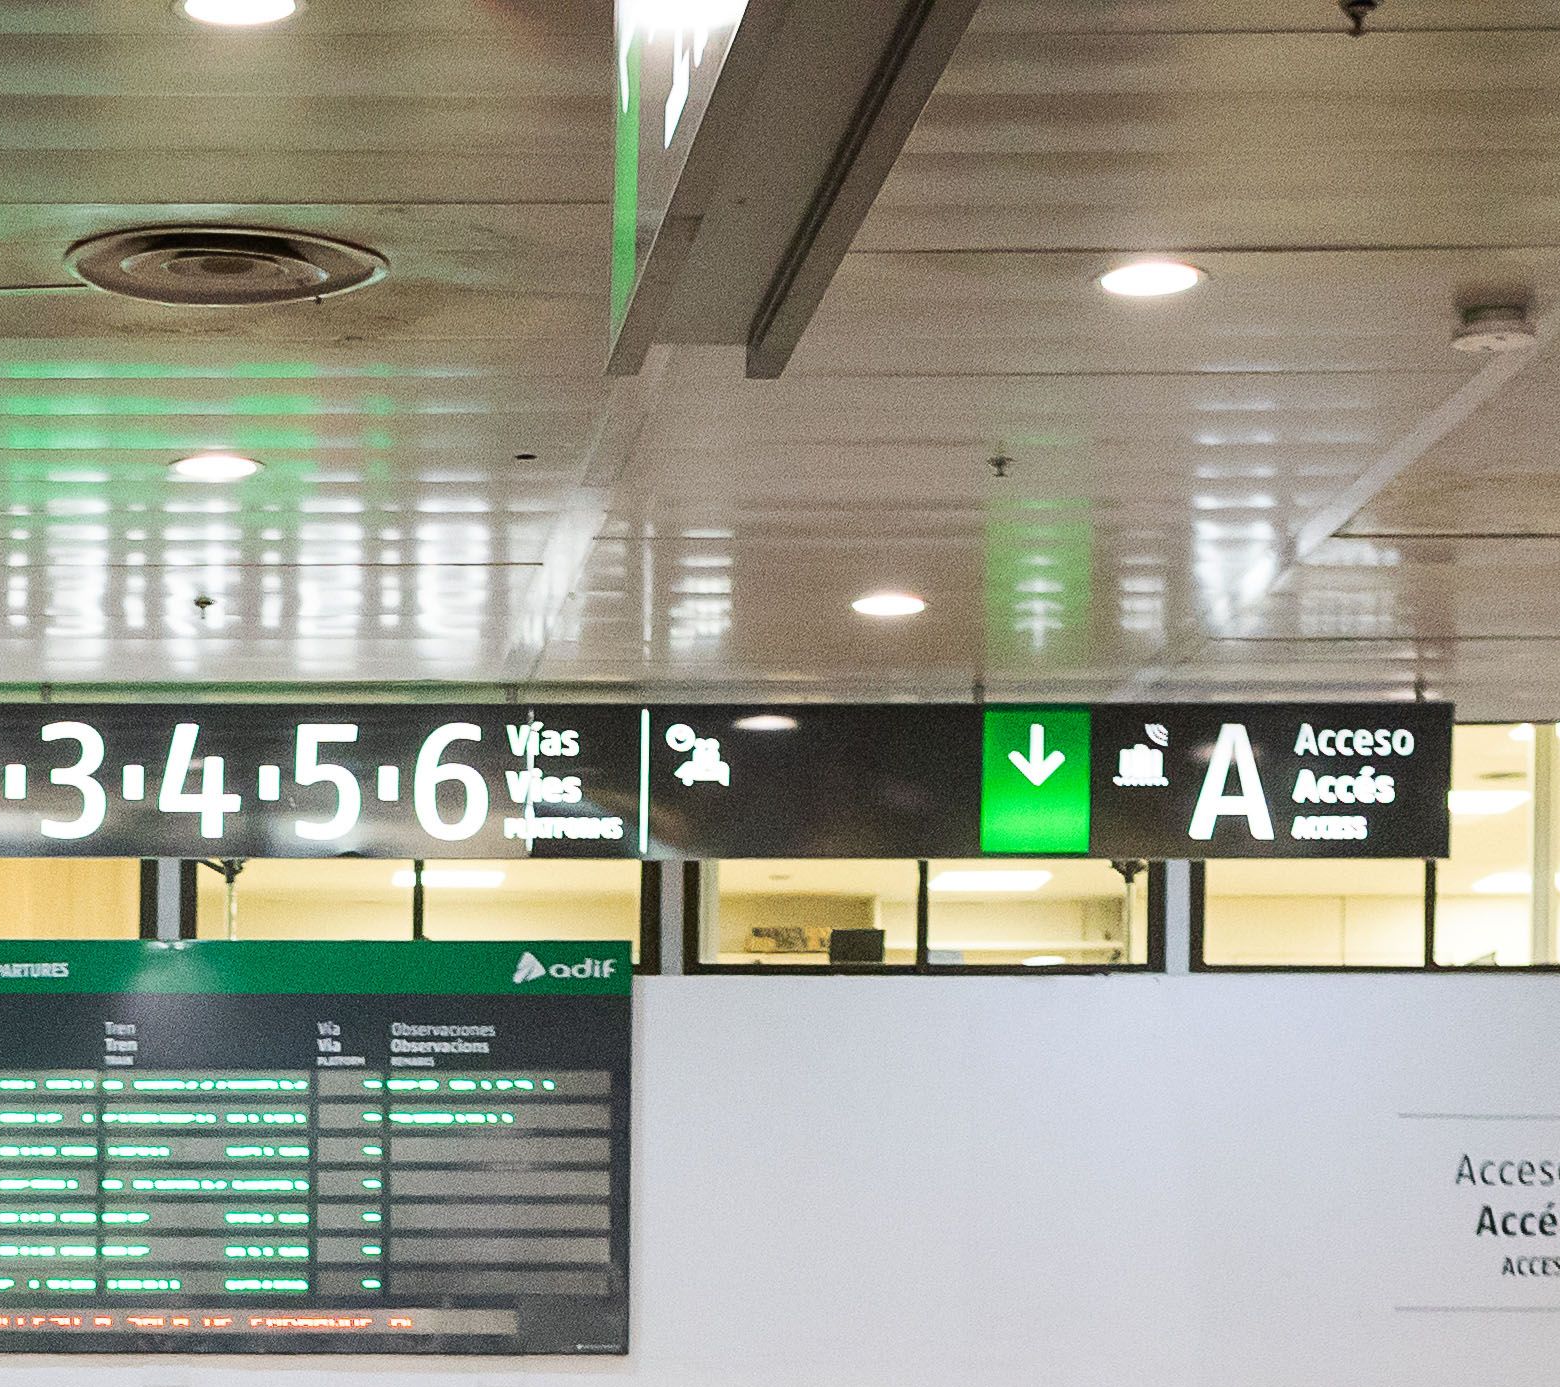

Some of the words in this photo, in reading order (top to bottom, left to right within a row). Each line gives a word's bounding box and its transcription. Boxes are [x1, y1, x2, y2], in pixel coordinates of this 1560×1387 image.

[506, 720, 580, 757] Vías
[1293, 722, 1415, 757] Acceso
[504, 767, 583, 804] Vies
[1188, 723, 1275, 841] A
[1291, 765, 1396, 804] Accés
[548, 957, 618, 979] adif
